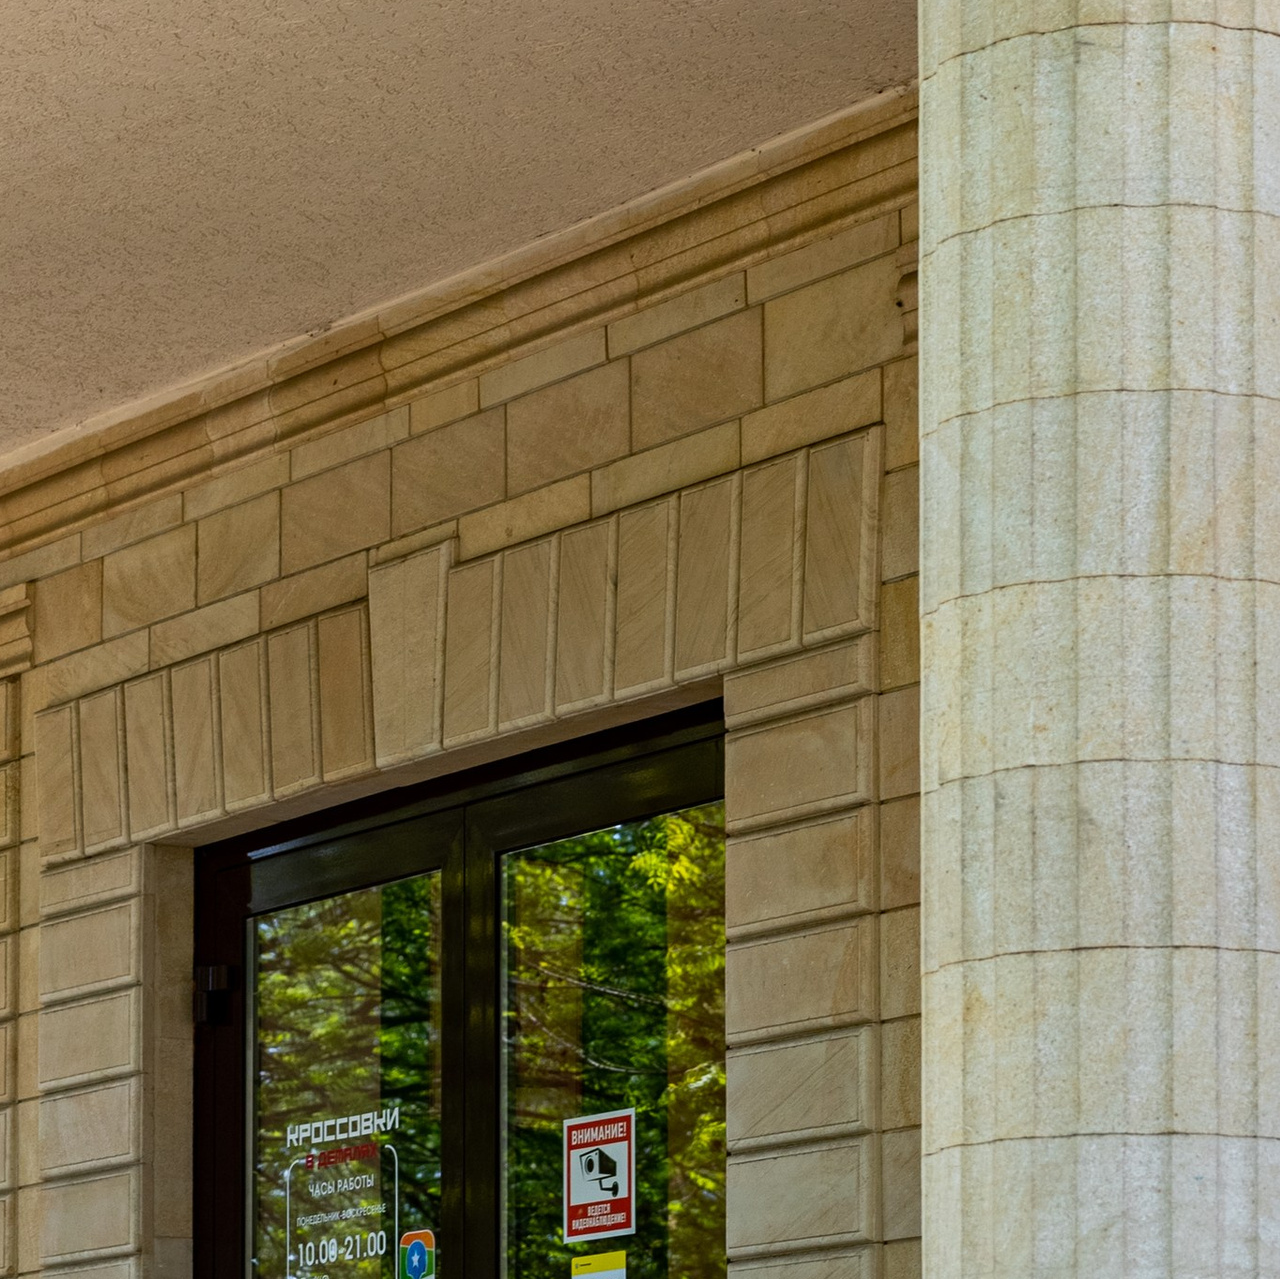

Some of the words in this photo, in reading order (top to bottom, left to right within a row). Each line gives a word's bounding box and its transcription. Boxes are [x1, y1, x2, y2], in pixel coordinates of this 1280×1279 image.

[286, 1107, 399, 1148] КРОССОВКИ
[571, 1122, 627, 1145] ВНИМАНИЕ!
[308, 1180, 335, 1197] ЧАСЫ
[337, 1174, 375, 1193] РАБОТЫ
